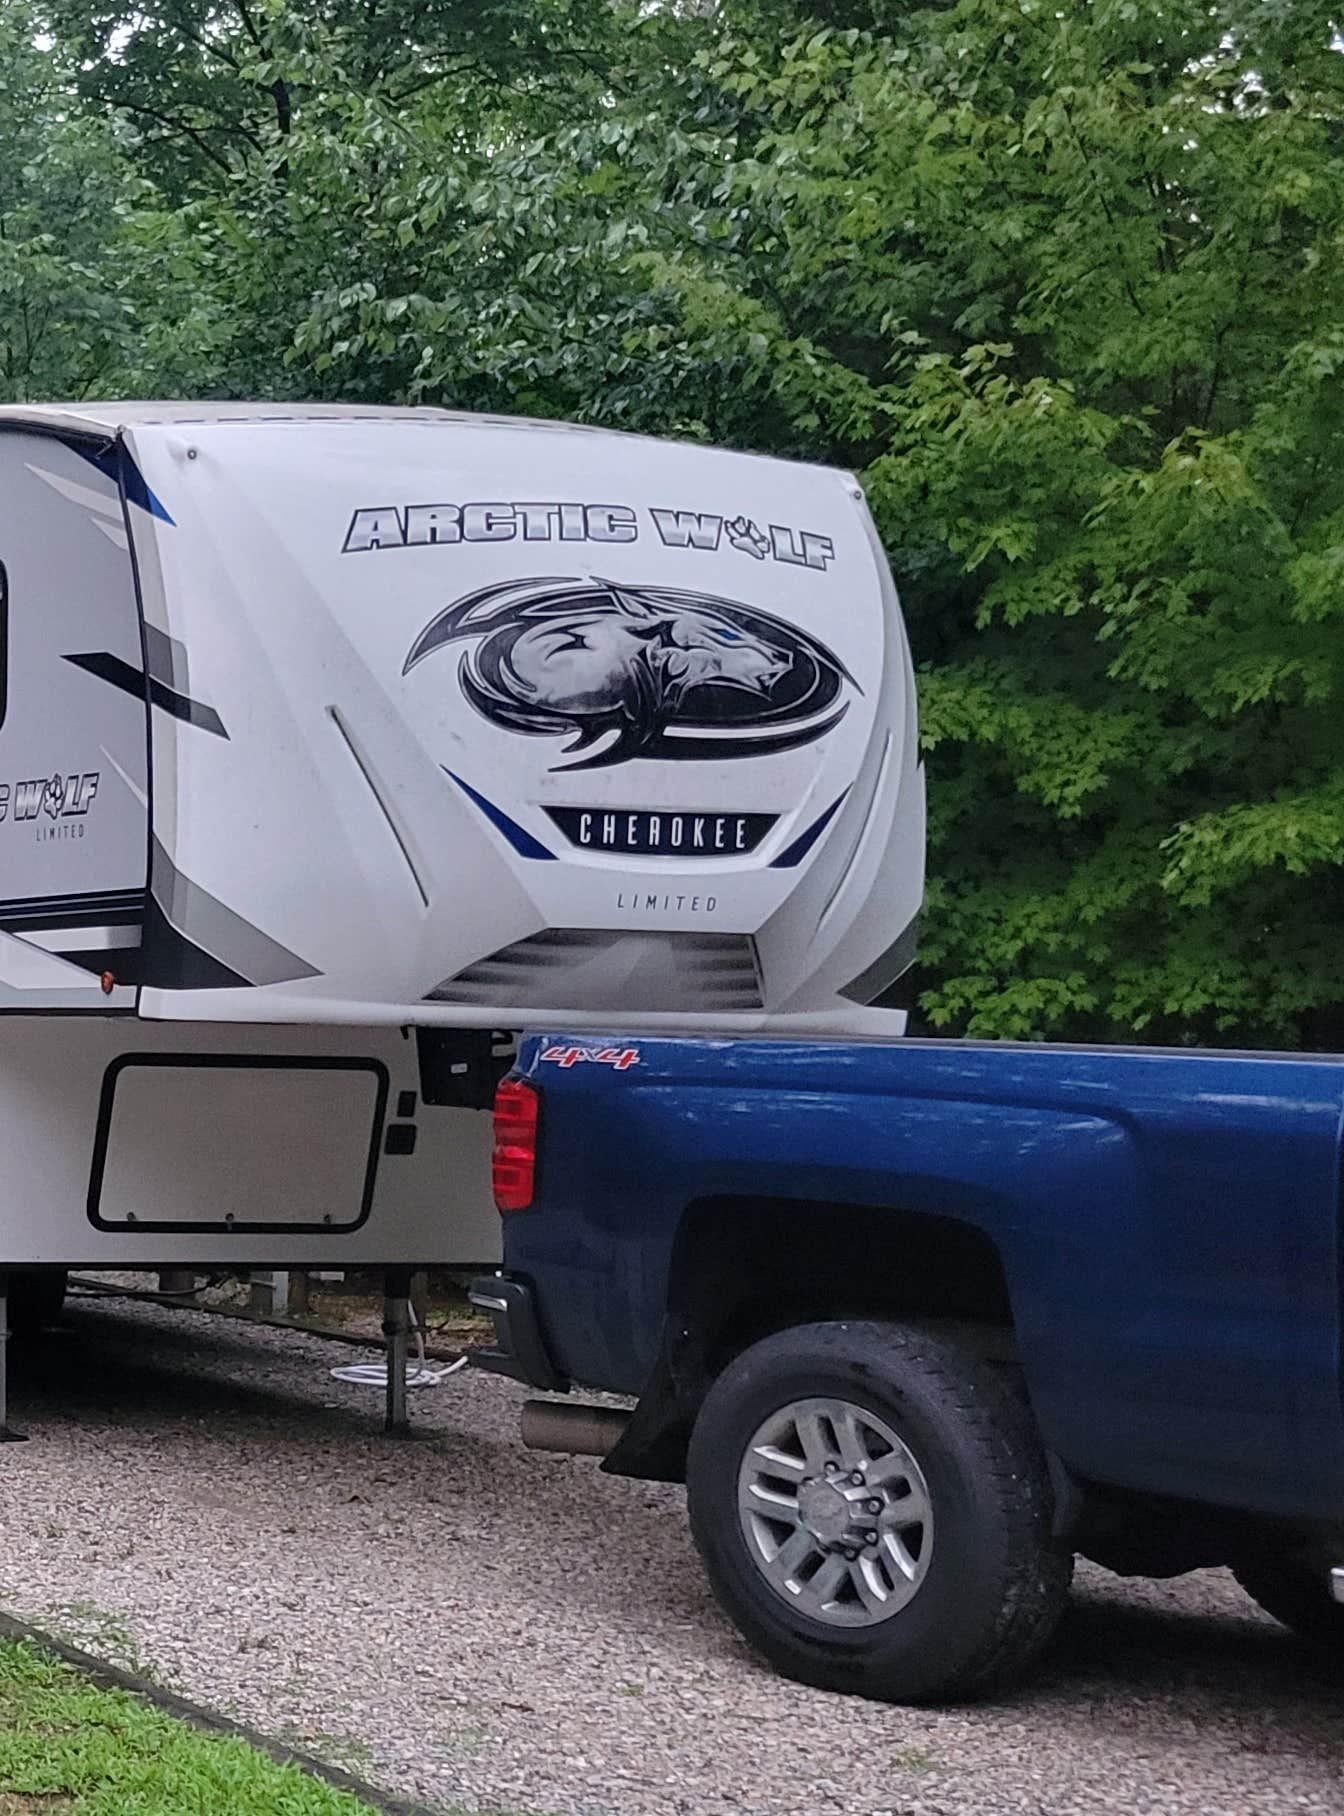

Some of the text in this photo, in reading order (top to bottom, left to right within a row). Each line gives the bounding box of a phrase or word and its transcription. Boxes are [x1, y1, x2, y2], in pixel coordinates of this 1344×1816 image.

[340, 502, 638, 553] ARCTIC
[36, 823, 85, 842] LIMITED
[579, 813, 747, 848] CHEROKEE
[617, 893, 717, 912] LIMITED
